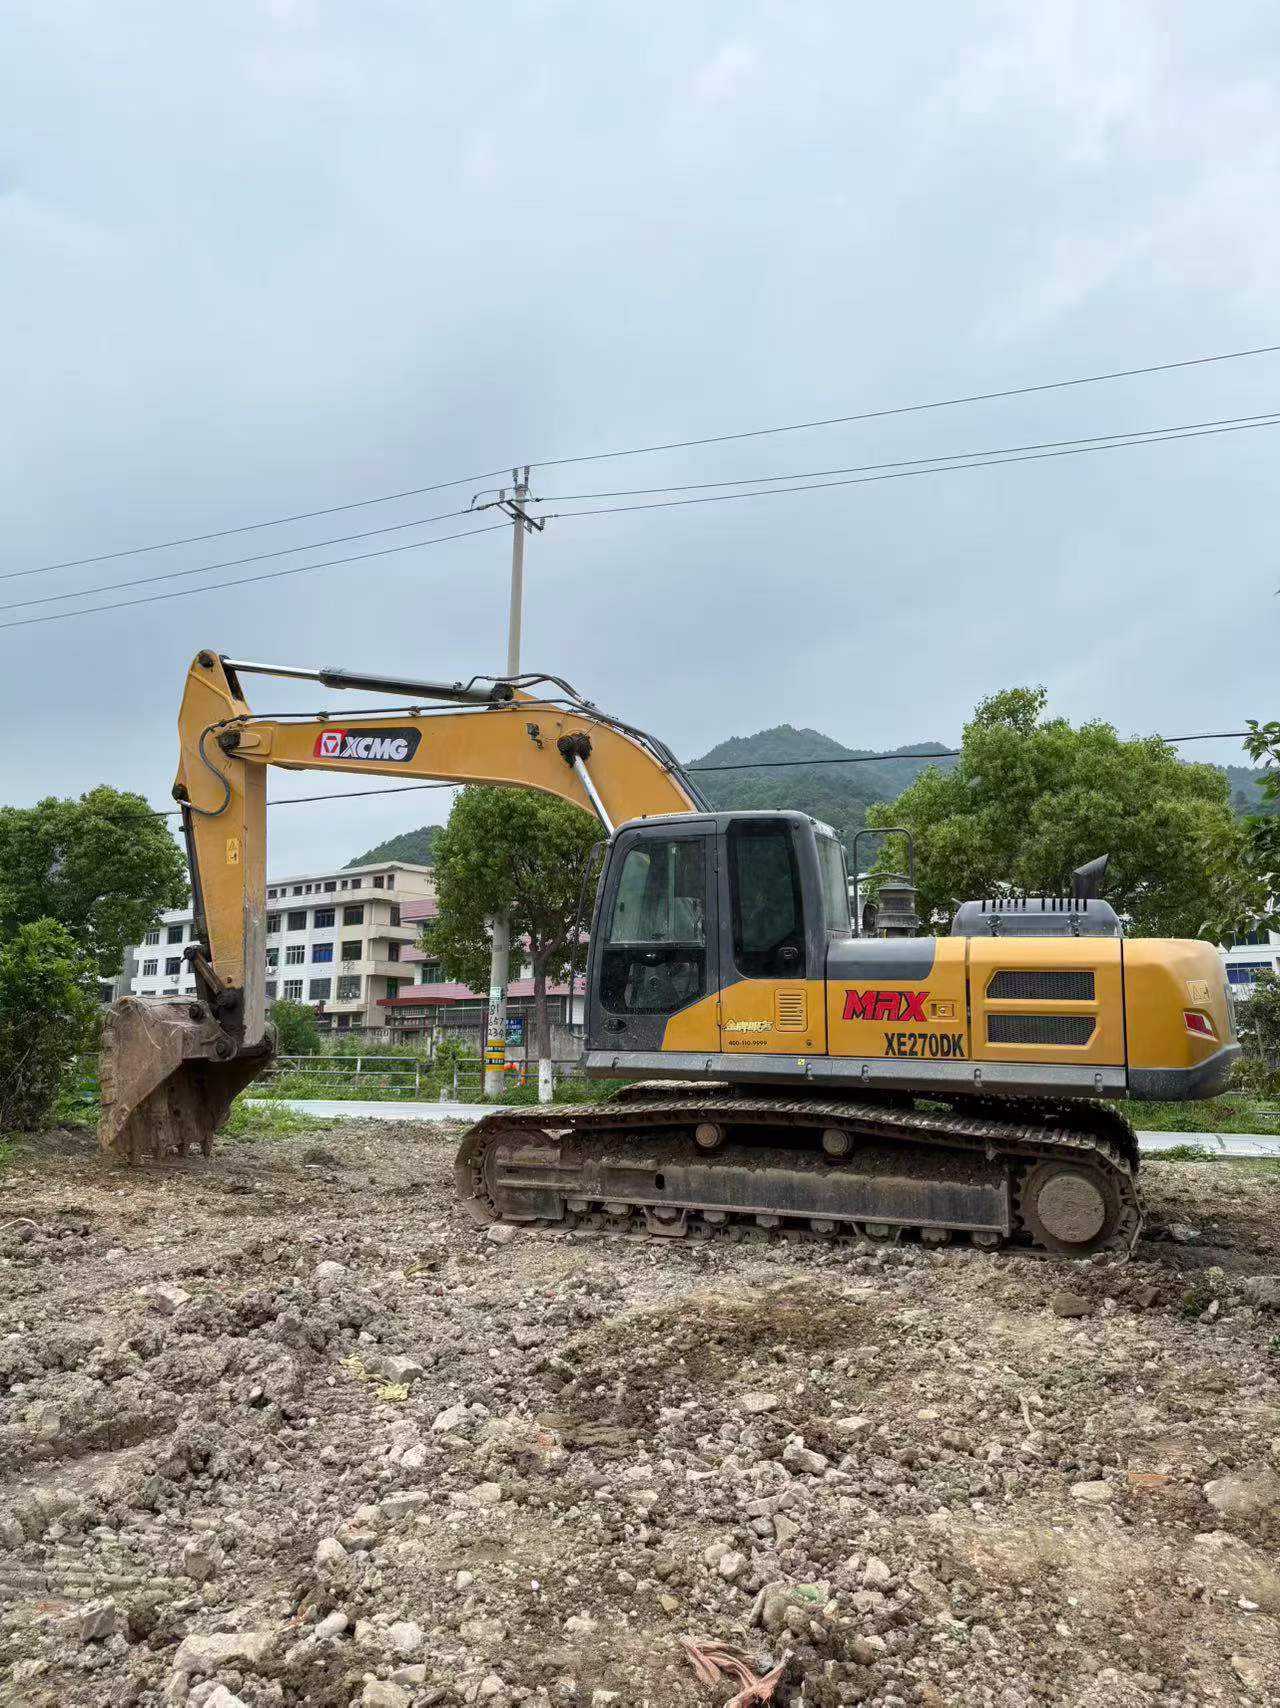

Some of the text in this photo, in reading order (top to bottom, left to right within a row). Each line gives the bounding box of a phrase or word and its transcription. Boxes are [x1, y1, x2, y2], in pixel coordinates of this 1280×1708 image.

[340, 736, 408, 760] XCMG
[842, 989, 931, 1022] MAX
[884, 1032, 966, 1058] XE270DK
